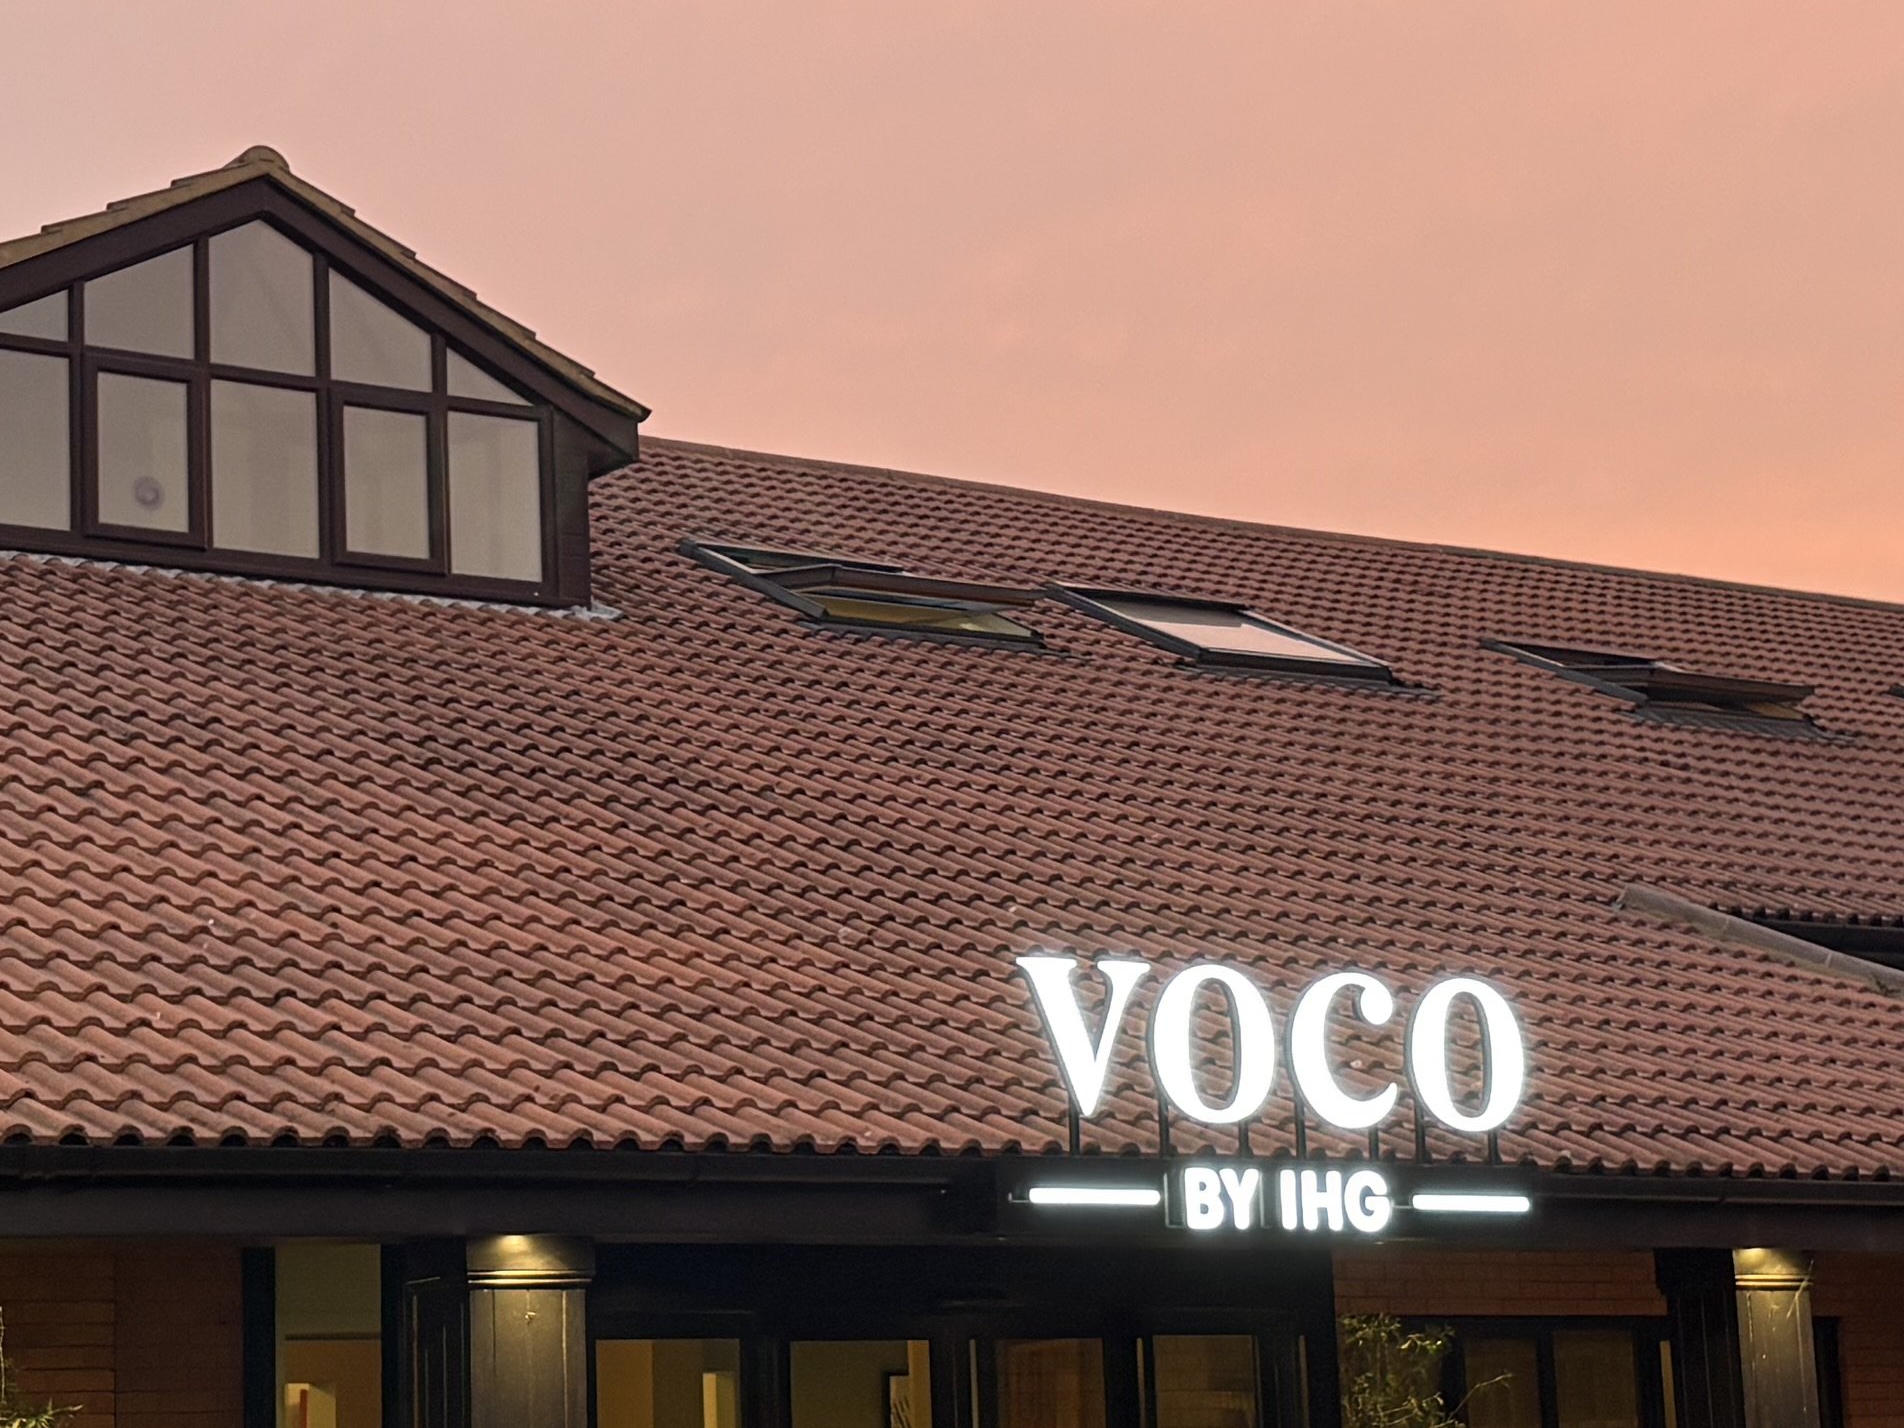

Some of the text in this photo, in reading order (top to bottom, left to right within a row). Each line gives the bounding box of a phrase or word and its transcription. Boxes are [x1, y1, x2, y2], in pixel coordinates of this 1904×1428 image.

[1015, 956, 1525, 1132] VOCO
[1184, 1167, 1392, 1232] BY IHG
